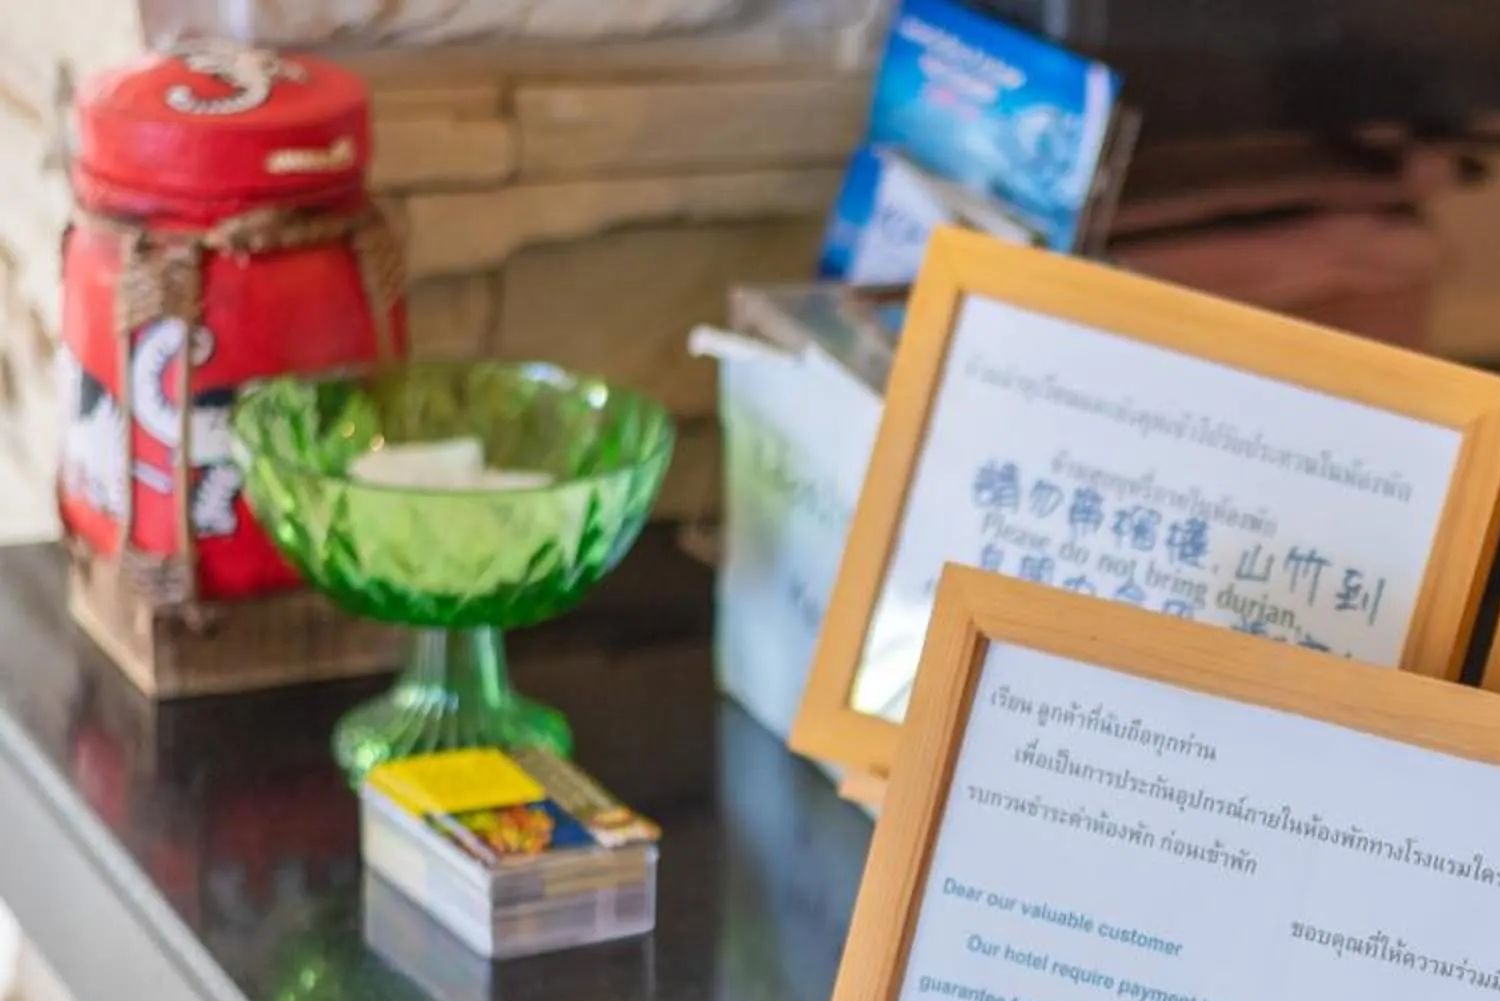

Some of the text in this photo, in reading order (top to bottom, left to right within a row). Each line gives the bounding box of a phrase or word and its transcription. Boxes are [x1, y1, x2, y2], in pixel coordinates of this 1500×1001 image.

[980, 510, 1052, 549] Please
[1056, 539, 1091, 566] do
[1097, 551, 1137, 579] not
[1143, 558, 1209, 611] bring
[990, 685, 1033, 716] เรียน
[943, 877, 1184, 957] Dear our valuable customer
[966, 933, 1001, 958] Our
[1003, 942, 1050, 972] hotel
[1051, 960, 1116, 990] require
